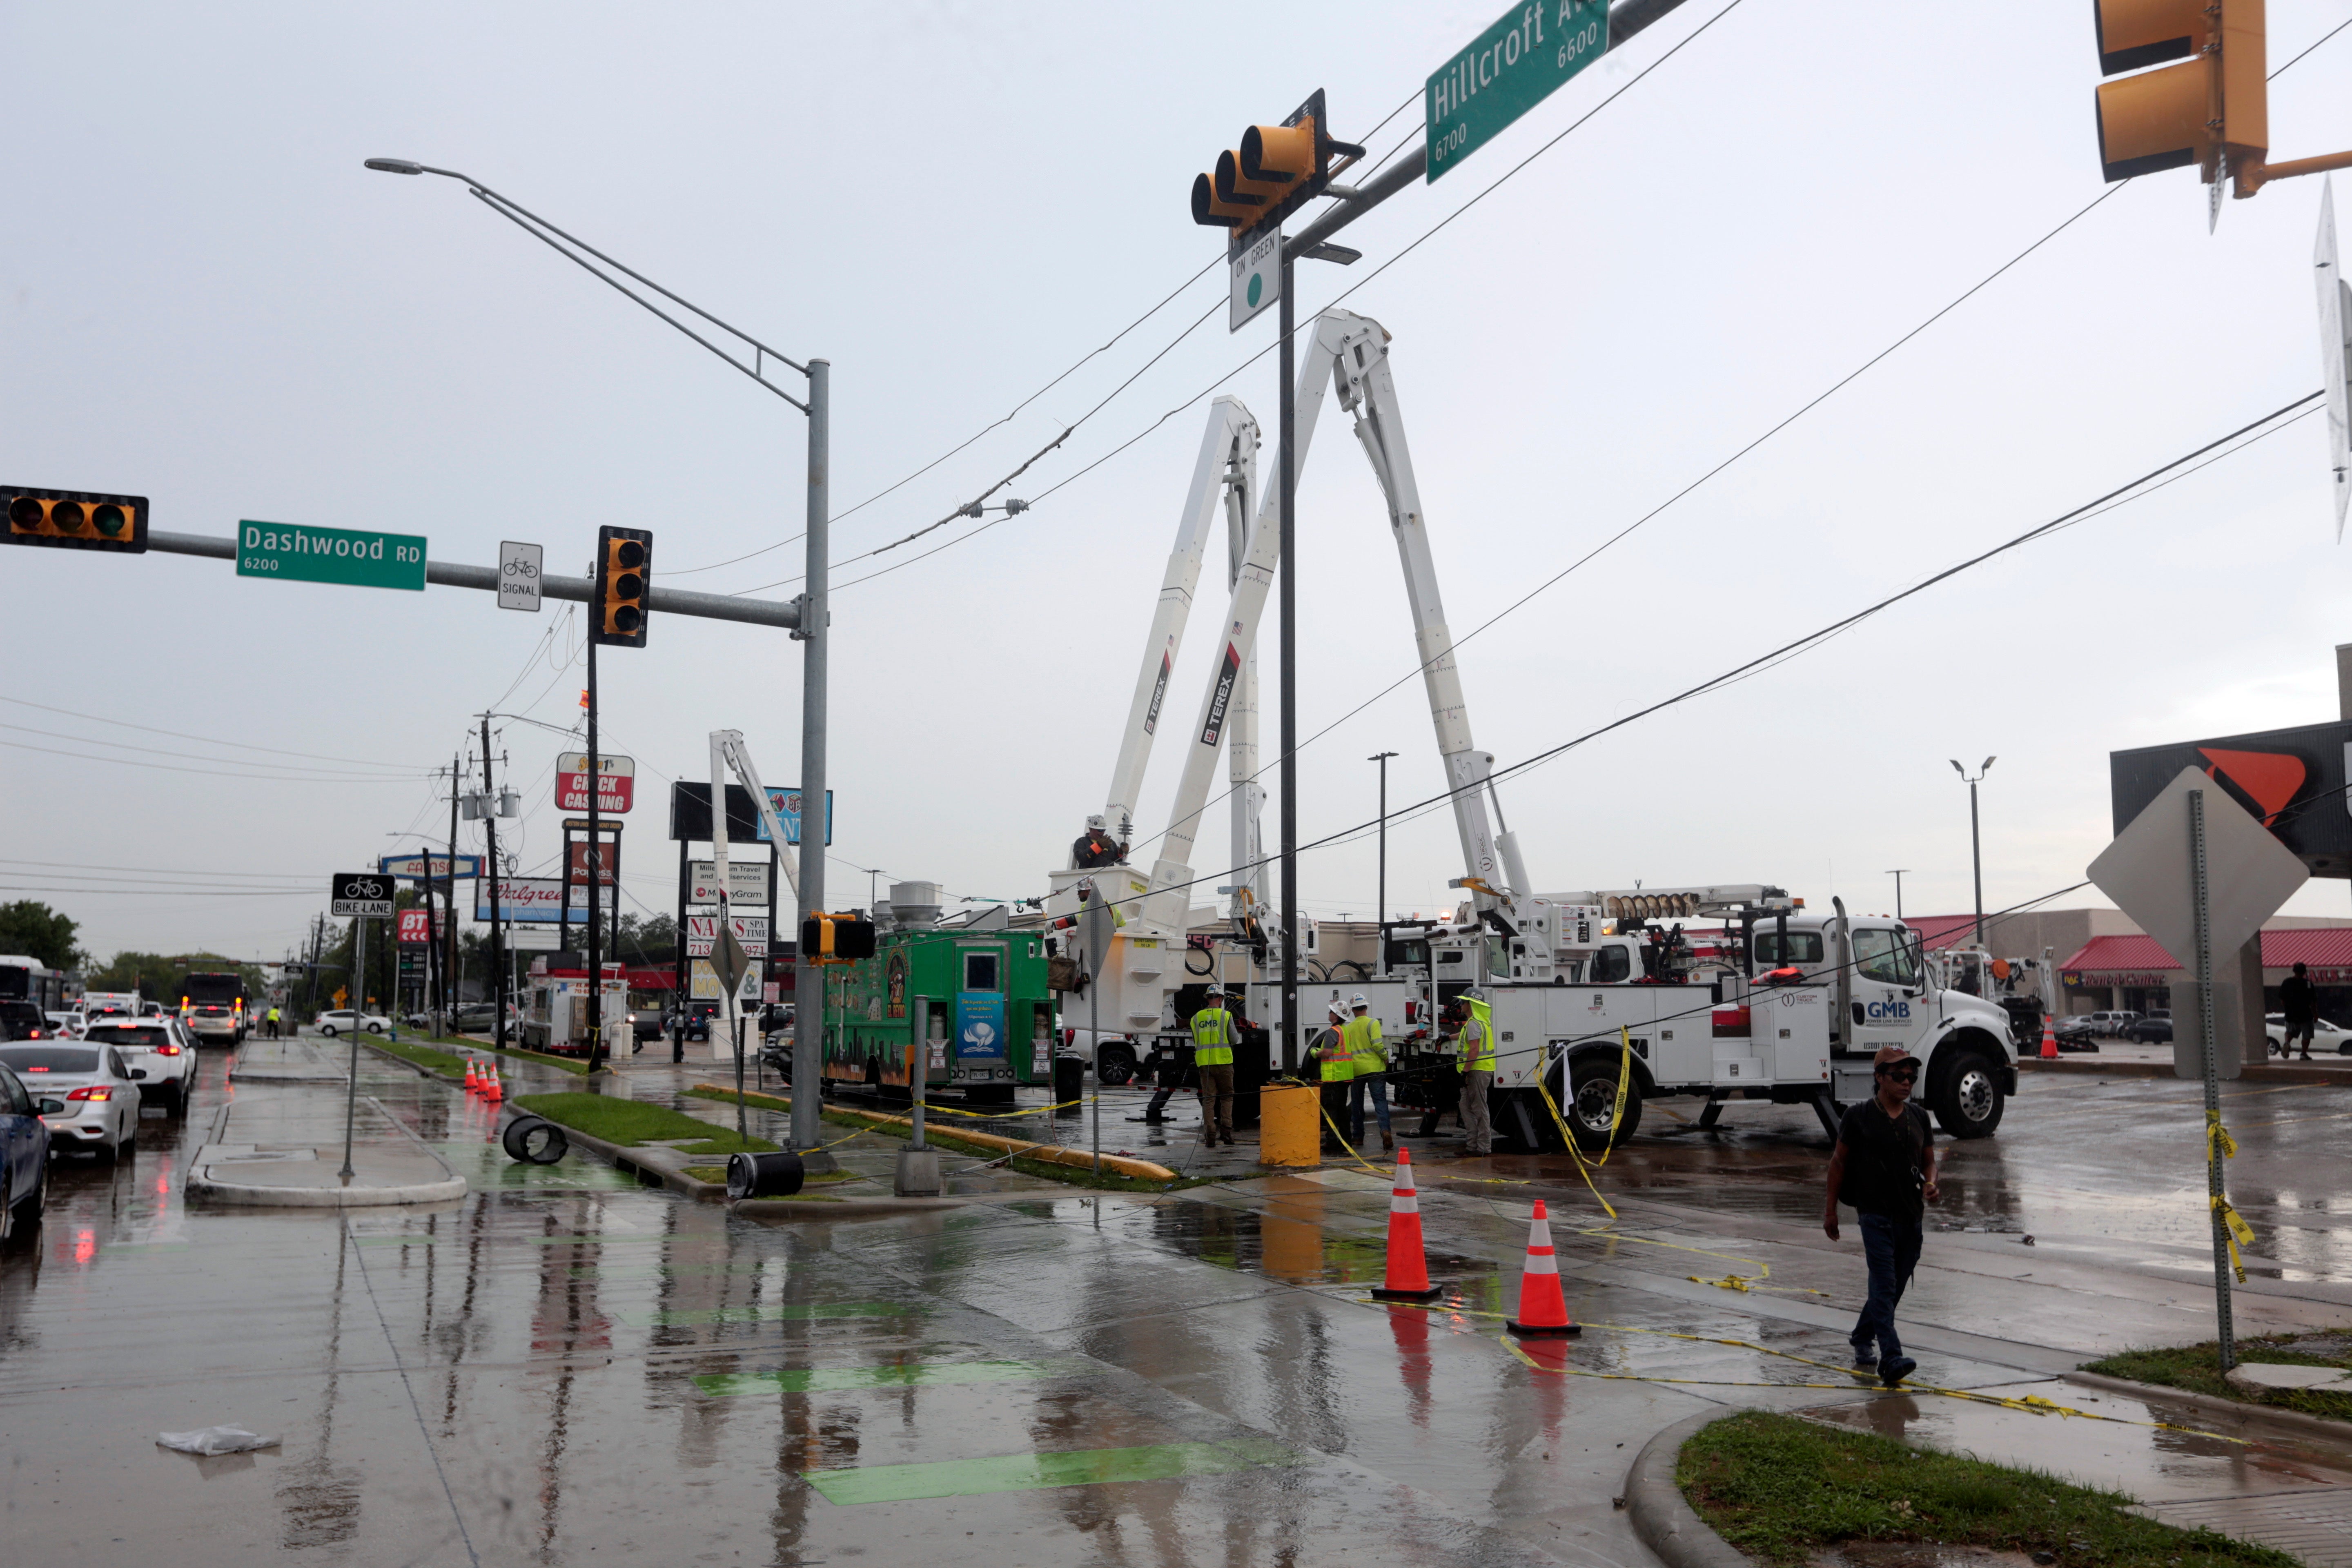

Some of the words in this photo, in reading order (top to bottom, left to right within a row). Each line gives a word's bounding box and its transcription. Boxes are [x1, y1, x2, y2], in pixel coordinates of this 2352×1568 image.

[1558, 22, 1597, 68] 6600
[1435, 1, 1544, 123] Hillcroft
[1436, 123, 1466, 161] 6700
[1237, 257, 1245, 278] ON
[1252, 233, 1274, 265] GREEN
[245, 527, 383, 560] Dashwood
[396, 546, 420, 563] RD
[245, 557, 278, 571] 6200
[503, 583, 537, 596] SIGNAL
[1150, 677, 1165, 717] TEREX
[1209, 676, 1232, 725] TEREX
[572, 775, 618, 793] CHCK
[564, 792, 624, 811] CASING
[335, 902, 359, 913] BIKE
[363, 902, 390, 913] LANE
[514, 907, 556, 917] pharmacy
[2065, 976, 2079, 985] RAC
[1868, 1002, 1911, 1018] GMB
[1198, 1020, 1218, 1028] GMB
[1616, 1091, 1626, 1114] CUIDADO
